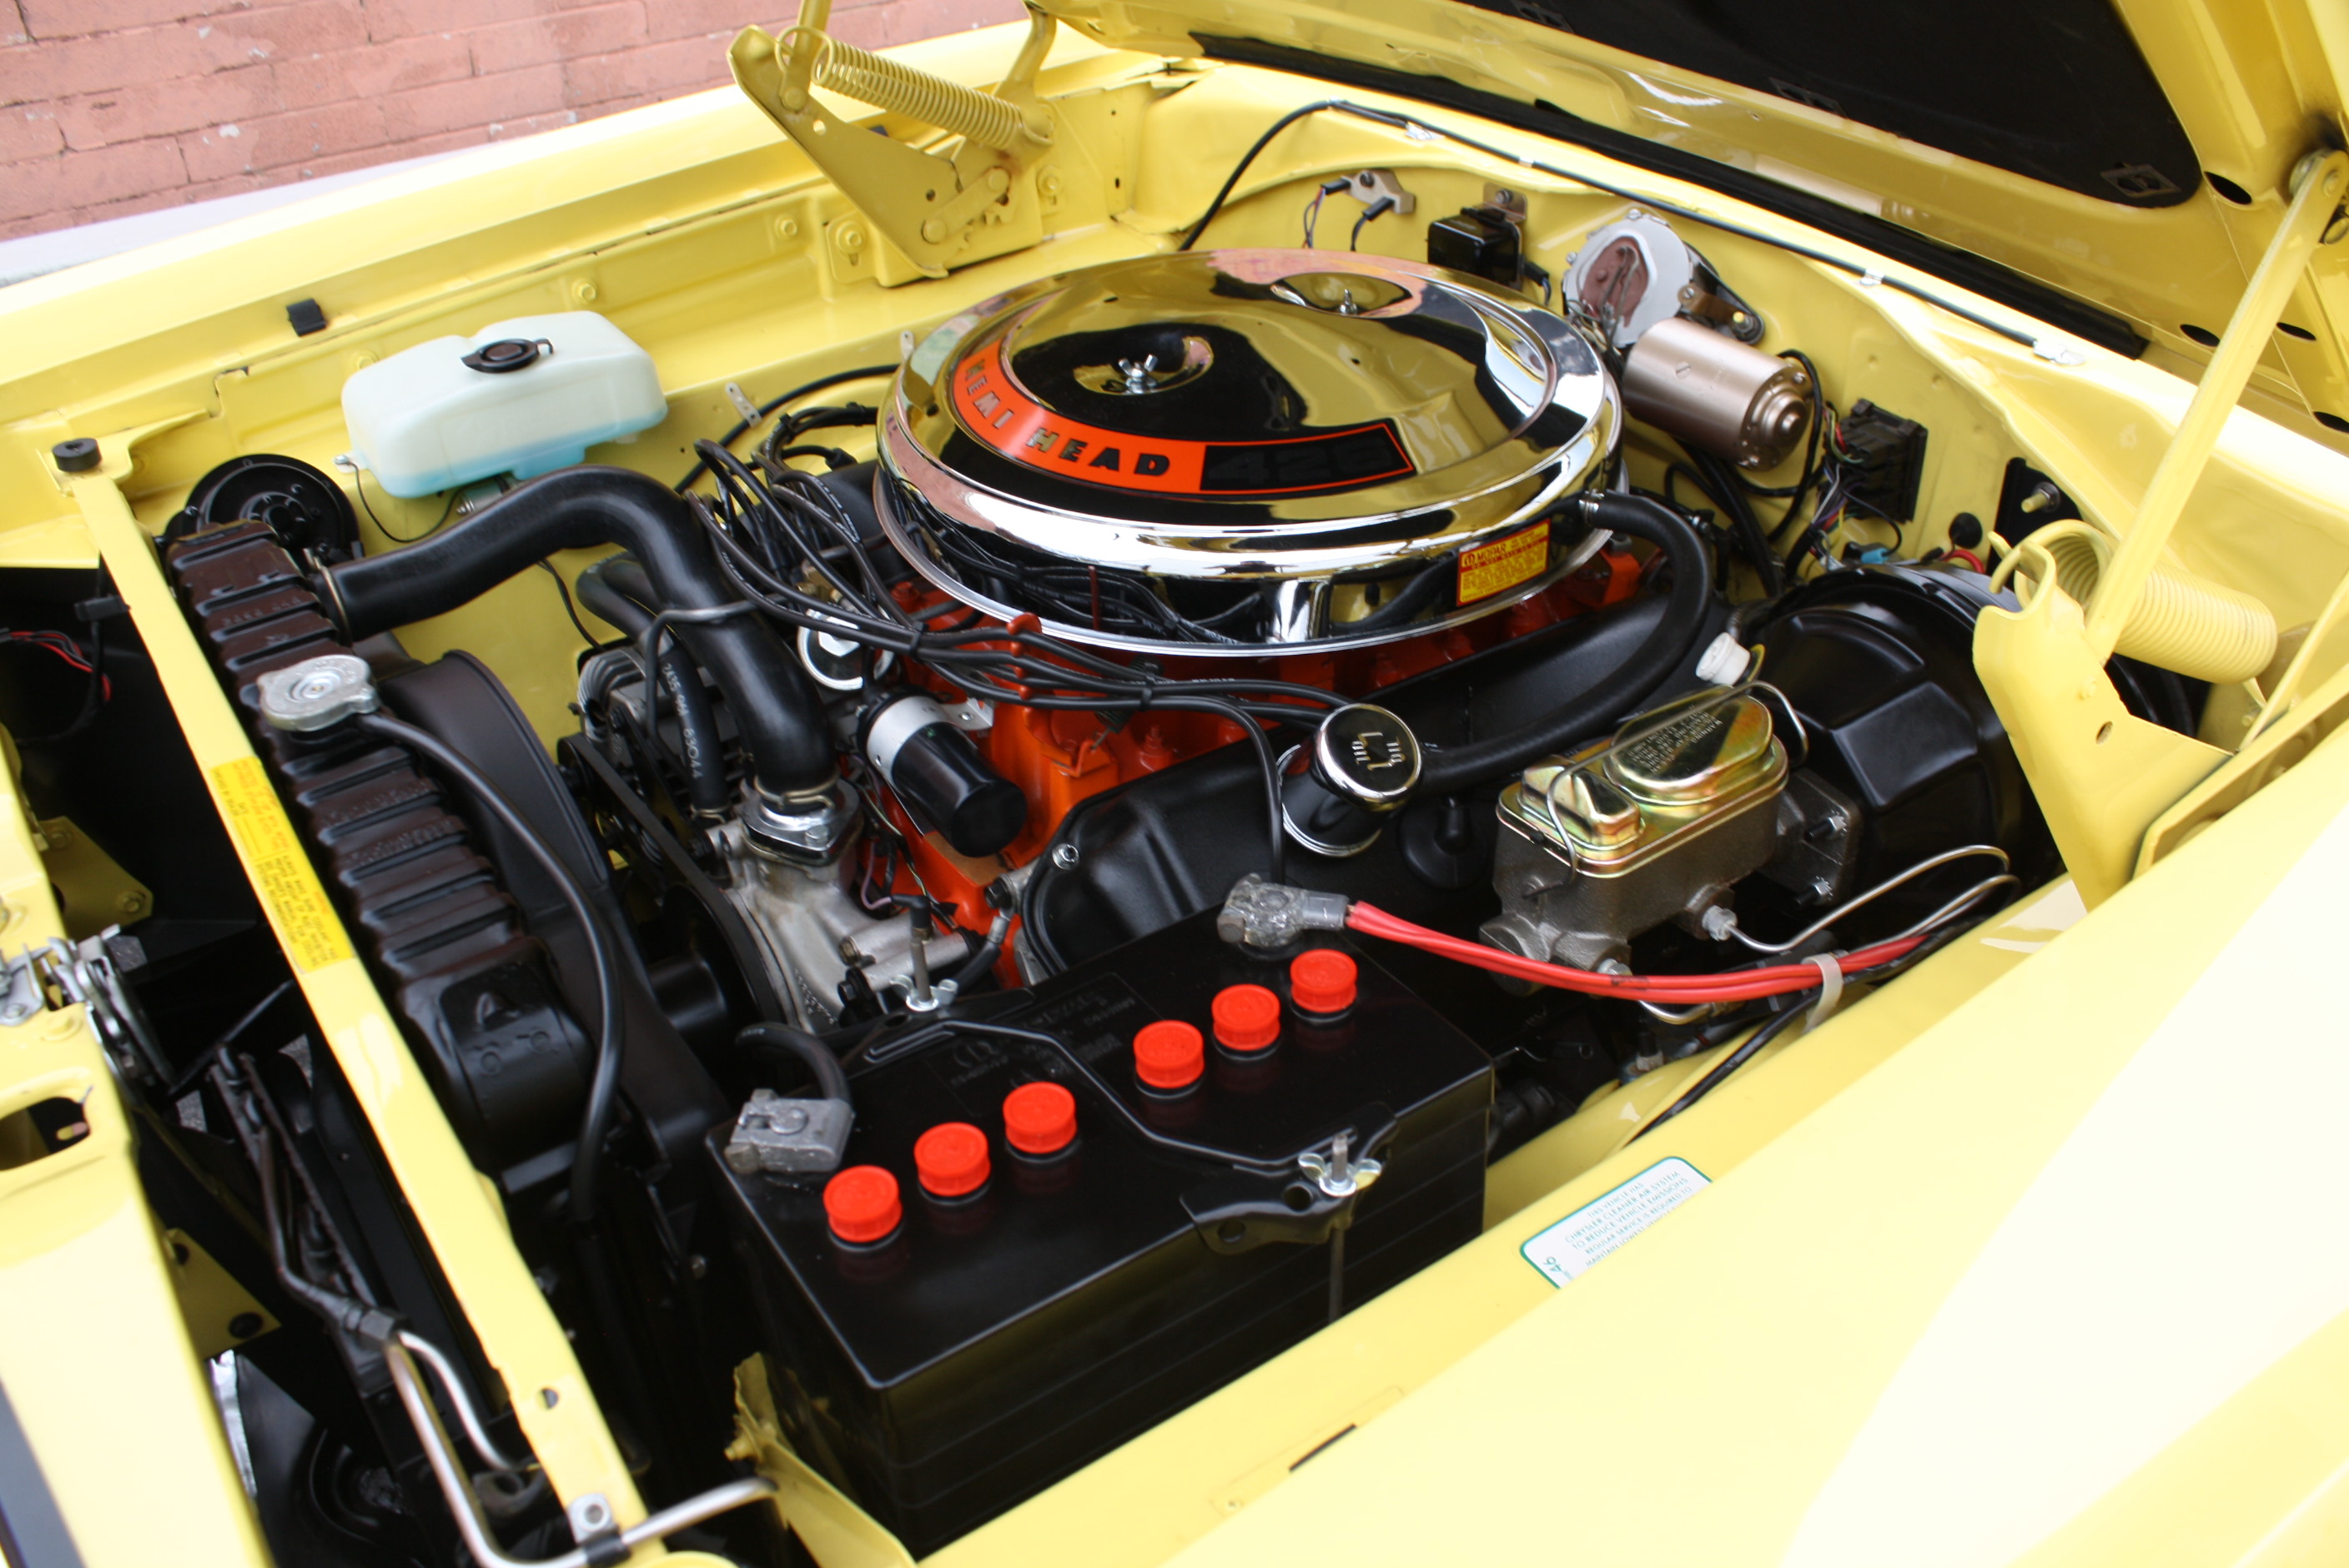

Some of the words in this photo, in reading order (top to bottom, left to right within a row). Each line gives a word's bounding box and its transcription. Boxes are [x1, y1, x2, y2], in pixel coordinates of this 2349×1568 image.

[964, 359, 1014, 430] HEMI
[1025, 427, 1170, 476] HEAD
[1207, 436, 1394, 485] 426
[1476, 542, 1506, 562] MOPAR
[1565, 1219, 1603, 1242] CHRYSLER
[1603, 1198, 1638, 1219] CLEANER
[1638, 1189, 1652, 1199] AIR
[1651, 1172, 1680, 1190] SYSTEM
[1572, 1241, 1585, 1249] TO
[1585, 1222, 1616, 1242] REDUCE
[1617, 1203, 1647, 1222] VEHICLE
[1647, 1179, 1688, 1204] EMISSIONS
[1585, 1234, 1616, 1254] REGULAR
[1617, 1215, 1646, 1234] SERVICE
[1650, 1194, 1682, 1214] REQUIRED
[1588, 1208, 1603, 1217] THIS
[1602, 1191, 1628, 1209] VEHICLE
[1629, 1184, 1643, 1193] HAS
